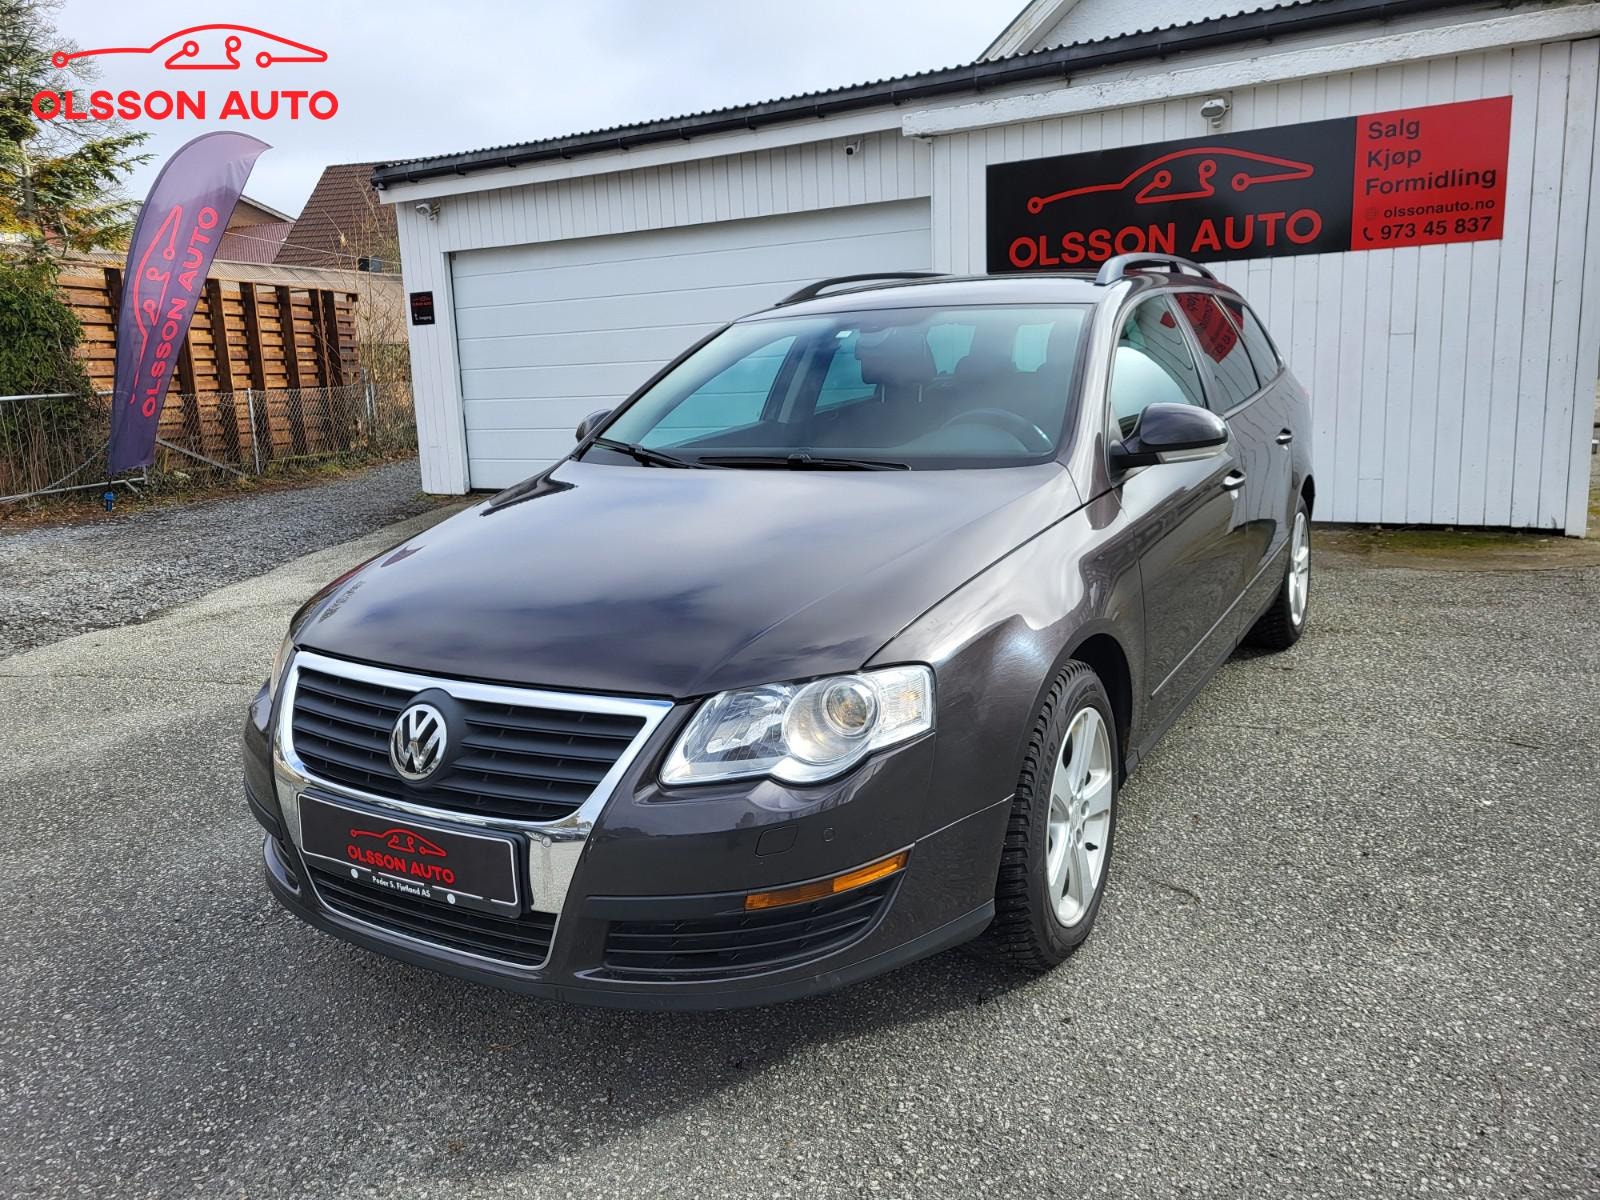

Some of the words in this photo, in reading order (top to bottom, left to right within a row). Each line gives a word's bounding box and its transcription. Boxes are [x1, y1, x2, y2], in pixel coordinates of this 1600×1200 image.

[1367, 117, 1421, 140] Salg
[1366, 148, 1422, 171] Kjøp
[1365, 168, 1497, 196] Formidling
[1383, 199, 1496, 219] olssonauto.no
[1008, 222, 1176, 268] OLSSON
[1190, 208, 1323, 253] AUTO
[1380, 223, 1416, 241] 973
[1422, 219, 1448, 237] 45
[1454, 215, 1493, 235] 837
[141, 297, 188, 418] OLSSON
[177, 206, 219, 293] AUTO
[347, 844, 407, 873] OLSSON
[410, 861, 456, 884] AUTO
